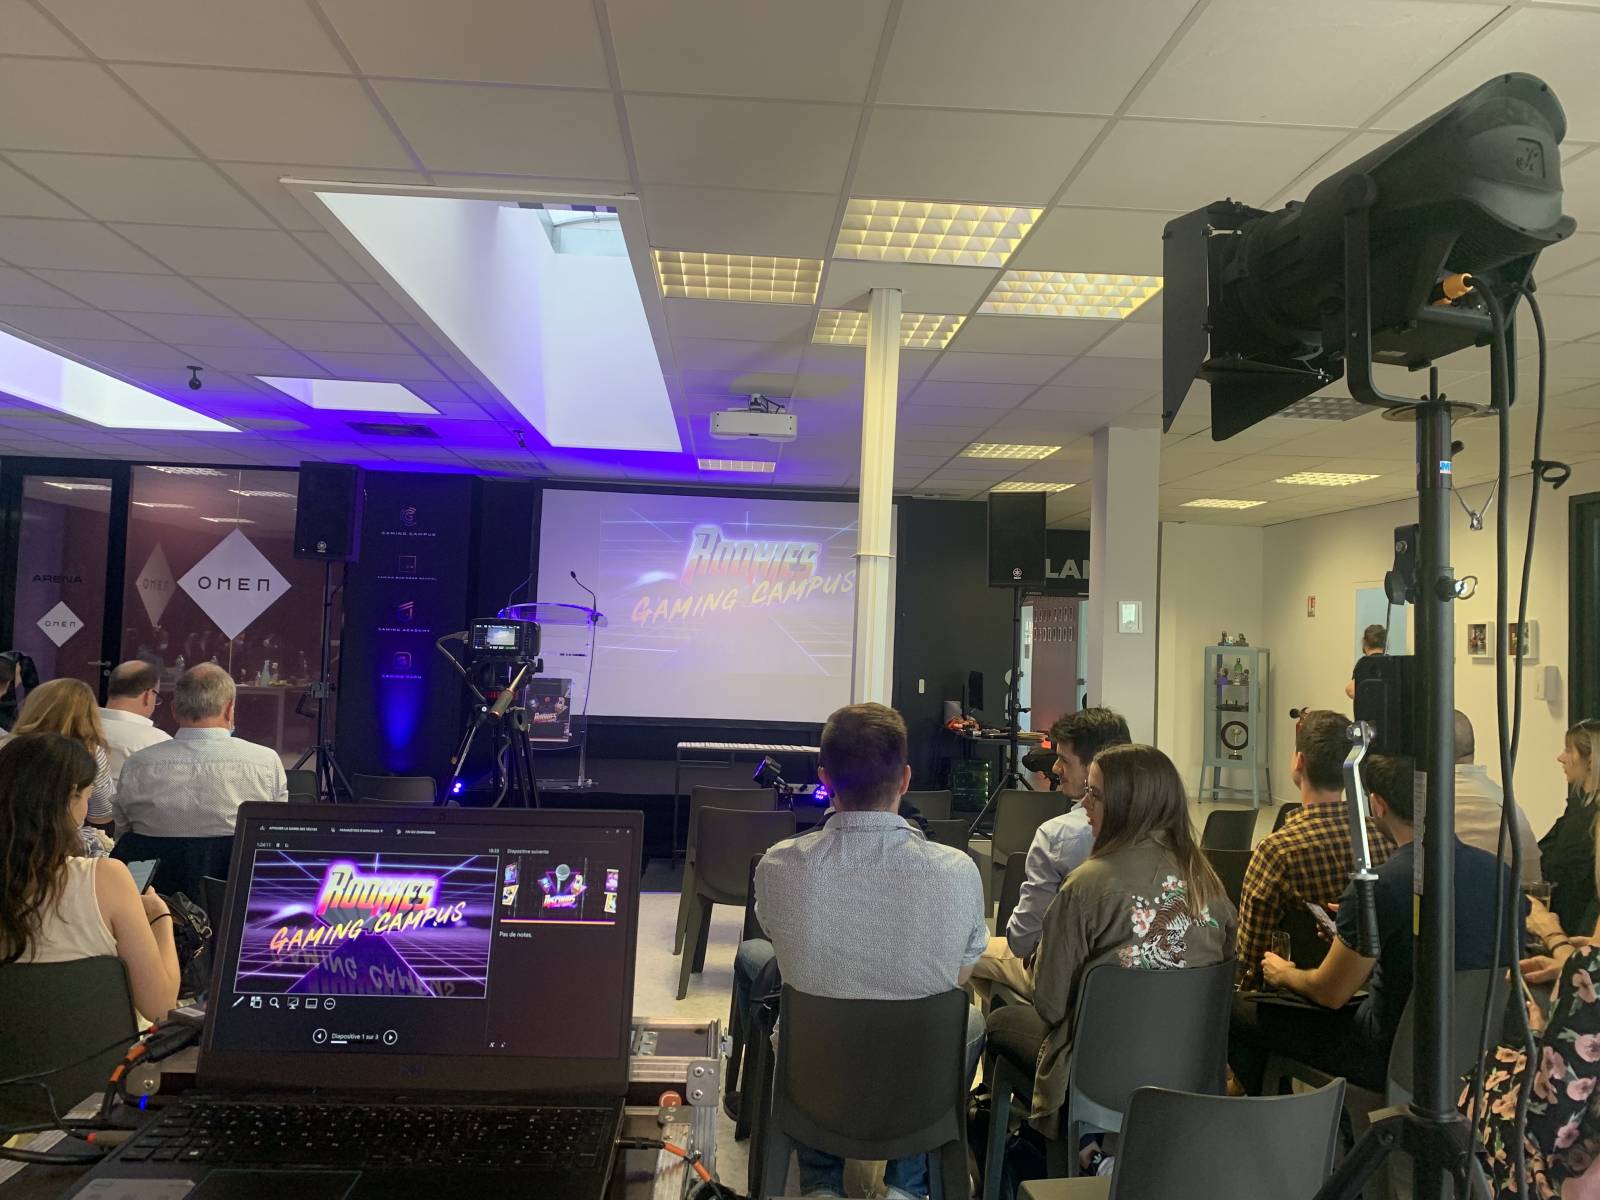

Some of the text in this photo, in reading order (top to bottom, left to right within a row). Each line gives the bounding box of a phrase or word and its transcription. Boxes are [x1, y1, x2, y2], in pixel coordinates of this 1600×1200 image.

[32, 574, 83, 584] ARENA
[197, 576, 271, 592] OMEN
[630, 568, 857, 627] GAMING CAMPUS
[317, 864, 436, 917] ROOKIES
[269, 901, 467, 955] GAMING CAMPUS
